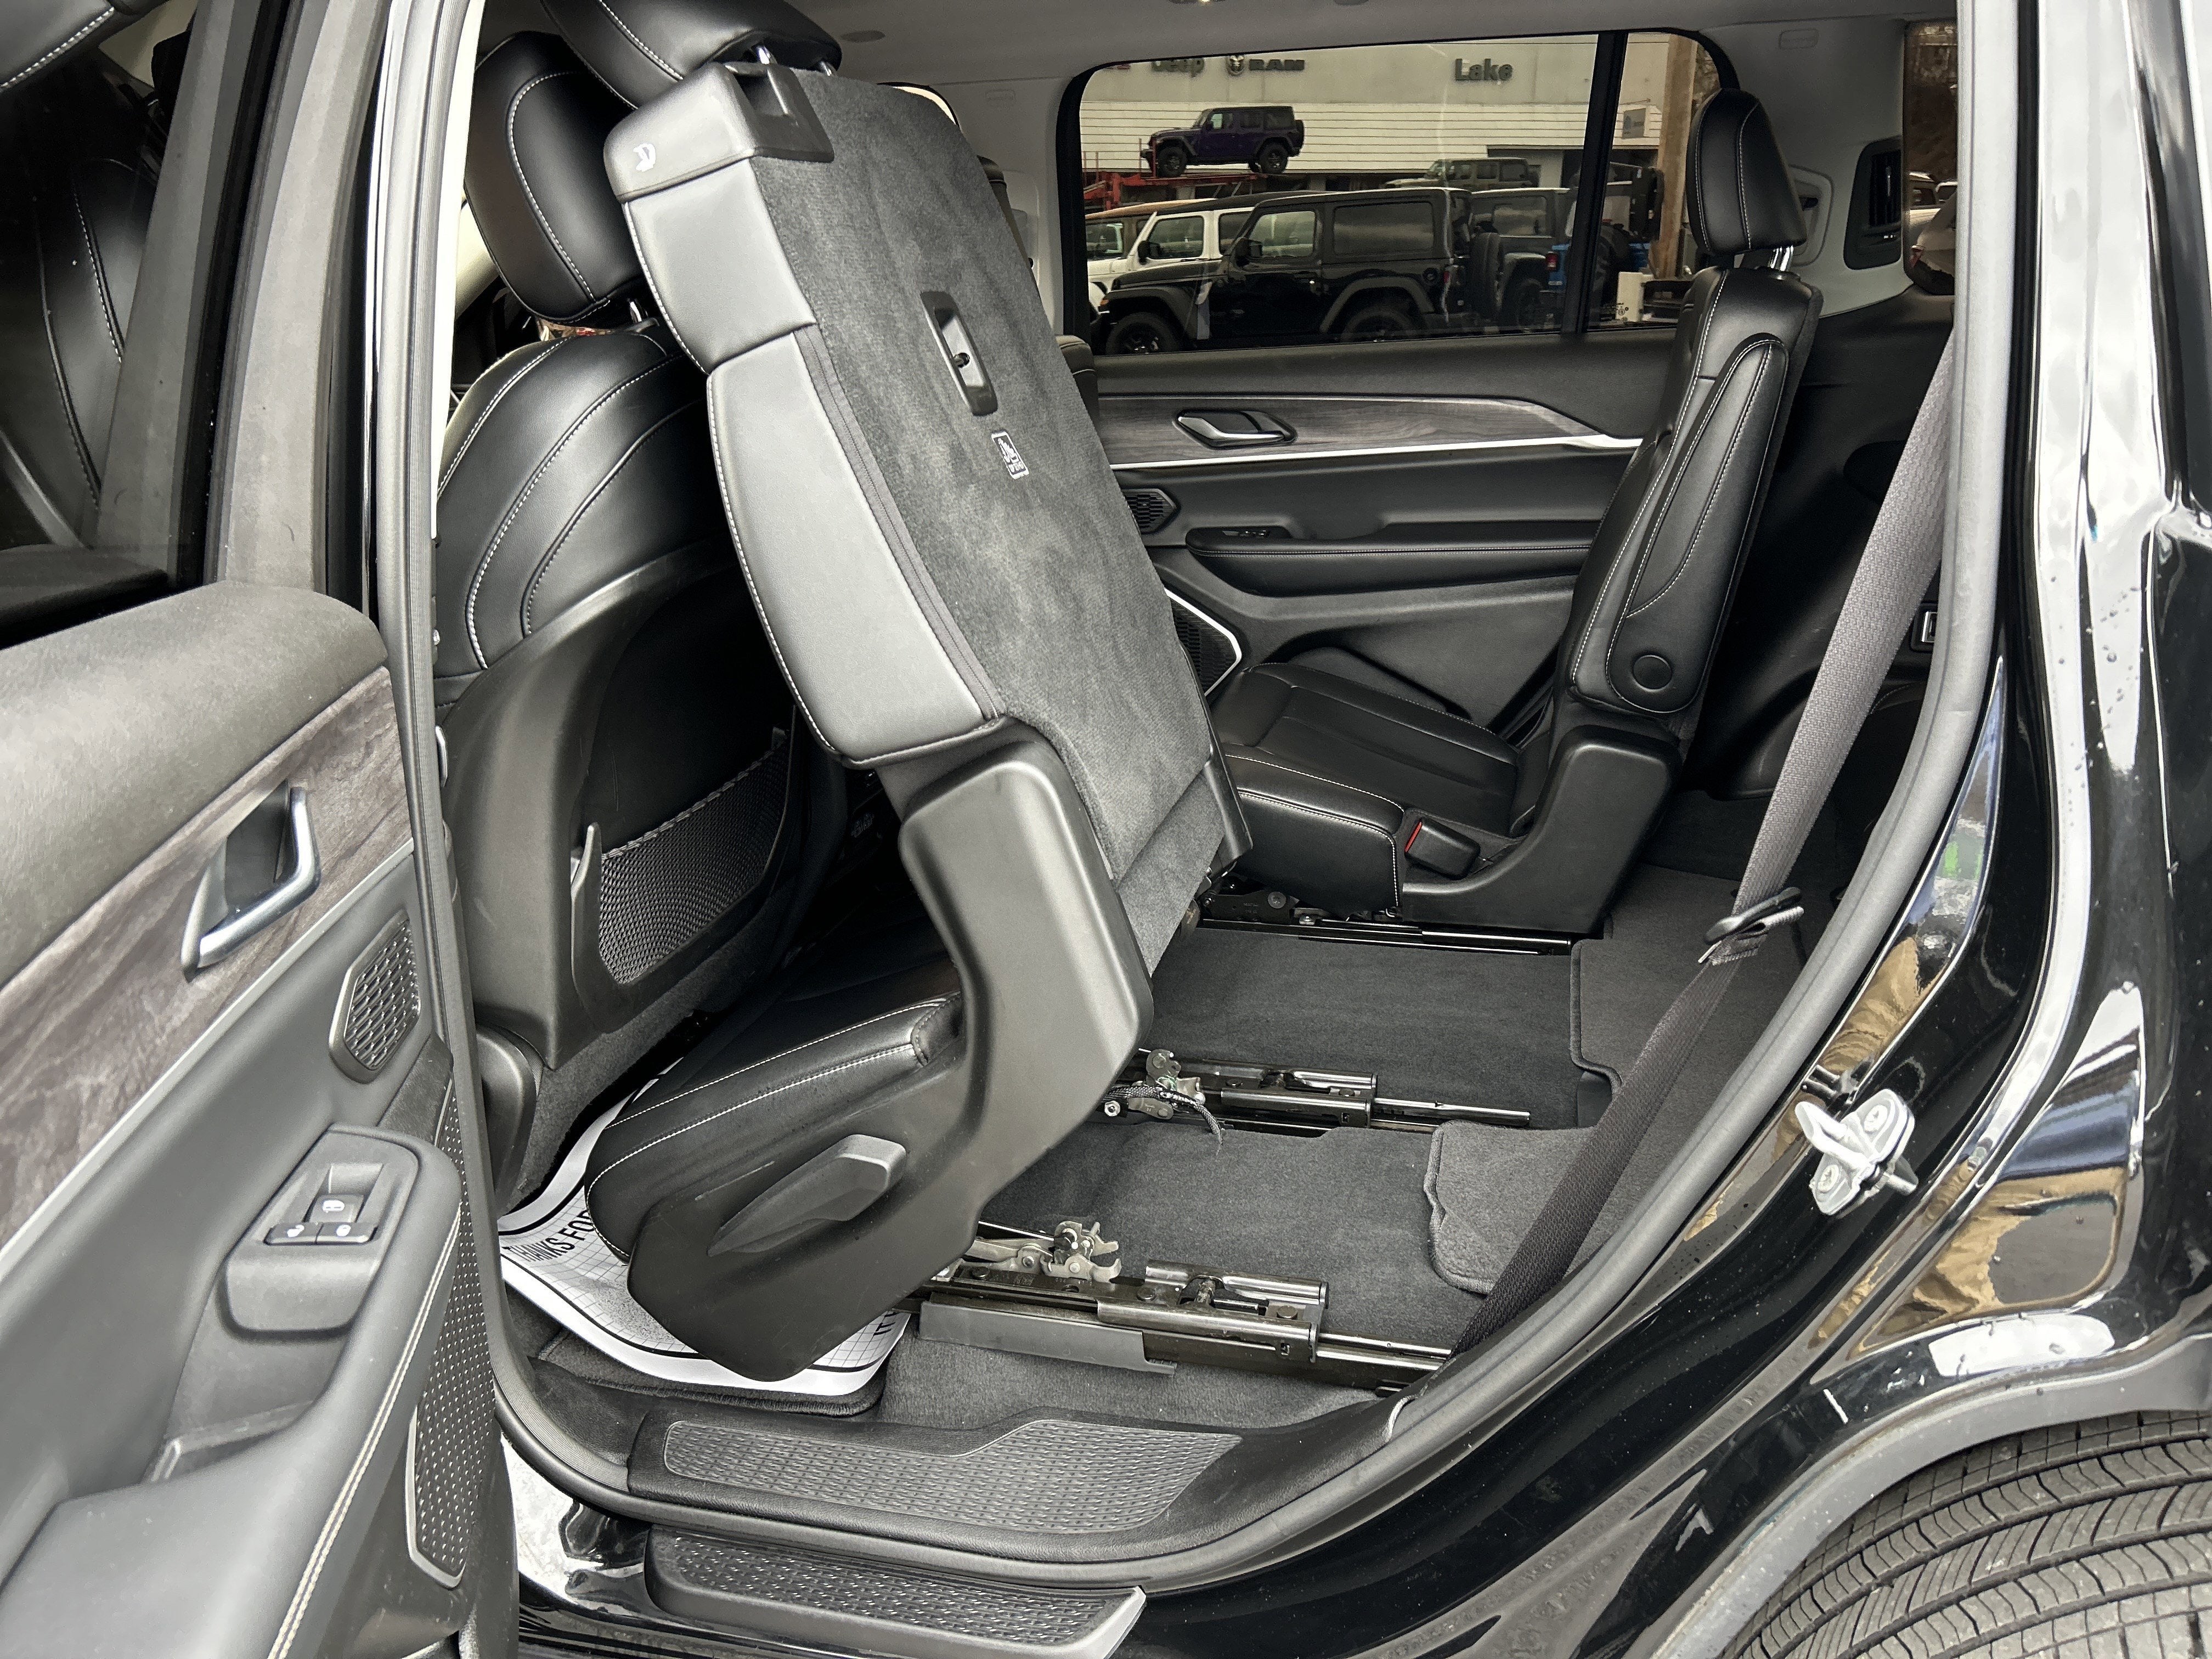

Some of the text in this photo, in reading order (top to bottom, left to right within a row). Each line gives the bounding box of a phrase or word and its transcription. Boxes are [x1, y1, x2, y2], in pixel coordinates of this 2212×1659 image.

[1249, 59, 1305, 71] RAM
[1454, 58, 1513, 81] Lake
[501, 1238, 575, 1262] THANKS
